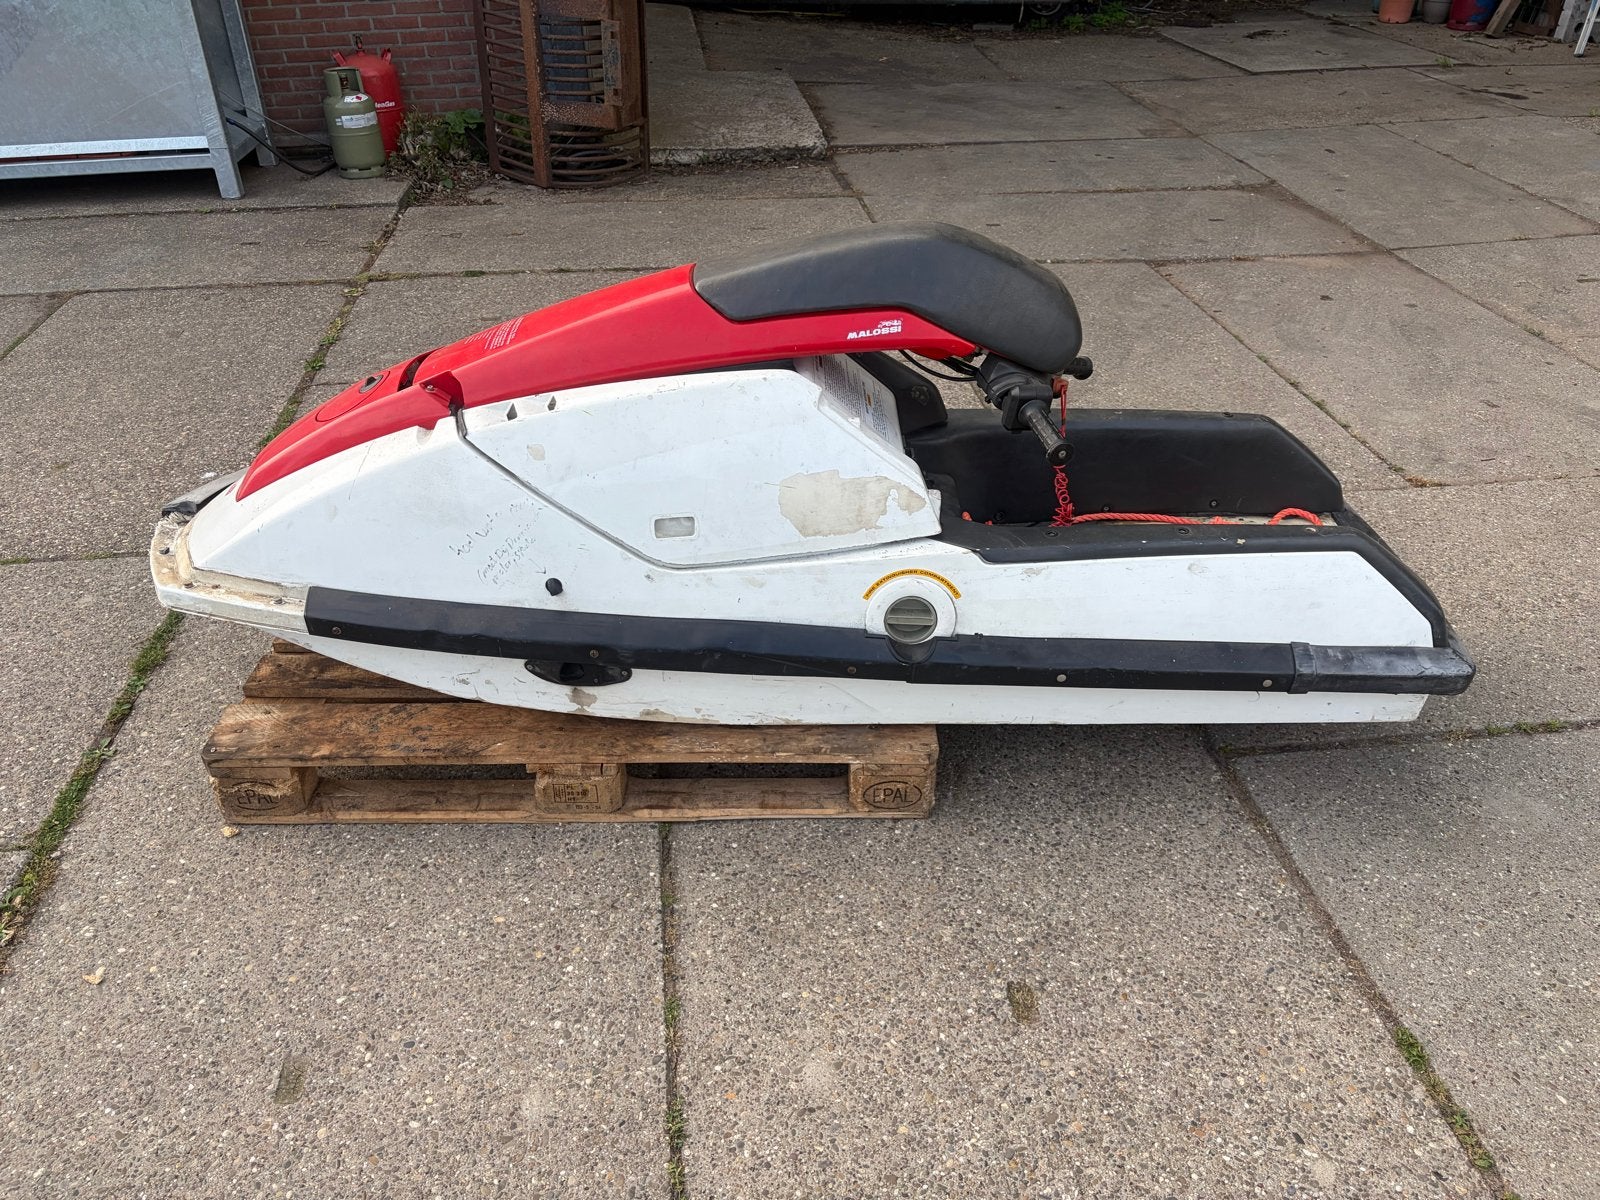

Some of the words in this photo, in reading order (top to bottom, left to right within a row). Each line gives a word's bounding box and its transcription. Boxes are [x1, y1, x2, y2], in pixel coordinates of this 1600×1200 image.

[846, 325, 902, 340] MALOSSI
[876, 569, 918, 587] EXTINGUISHER
[919, 569, 959, 597] COMPARTMENT
[873, 787, 913, 803] EPAL
